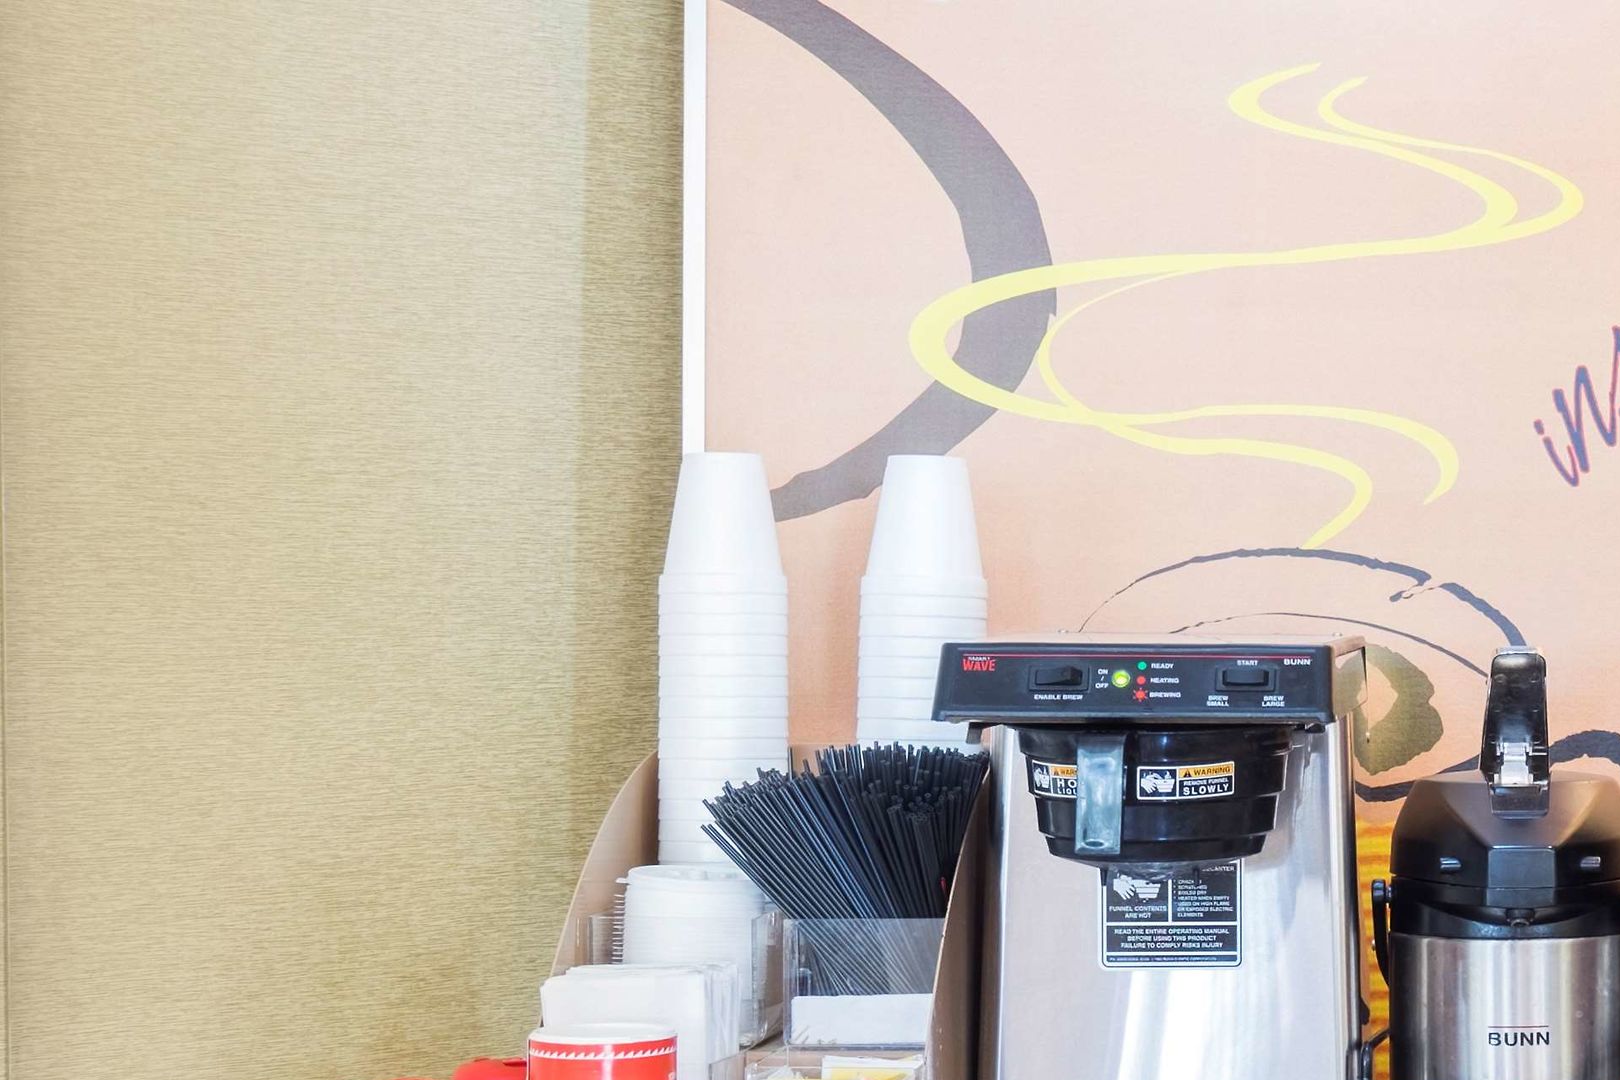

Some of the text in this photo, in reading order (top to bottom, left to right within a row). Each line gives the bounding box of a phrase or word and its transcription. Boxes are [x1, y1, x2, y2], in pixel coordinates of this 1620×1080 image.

[963, 659, 996, 671] WAVE
[1284, 658, 1311, 666] BUNN
[1194, 766, 1231, 776] WARNING
[1057, 778, 1077, 788] HO
[1183, 784, 1229, 795] SLOWLY
[1487, 1031, 1550, 1046] BUNN
